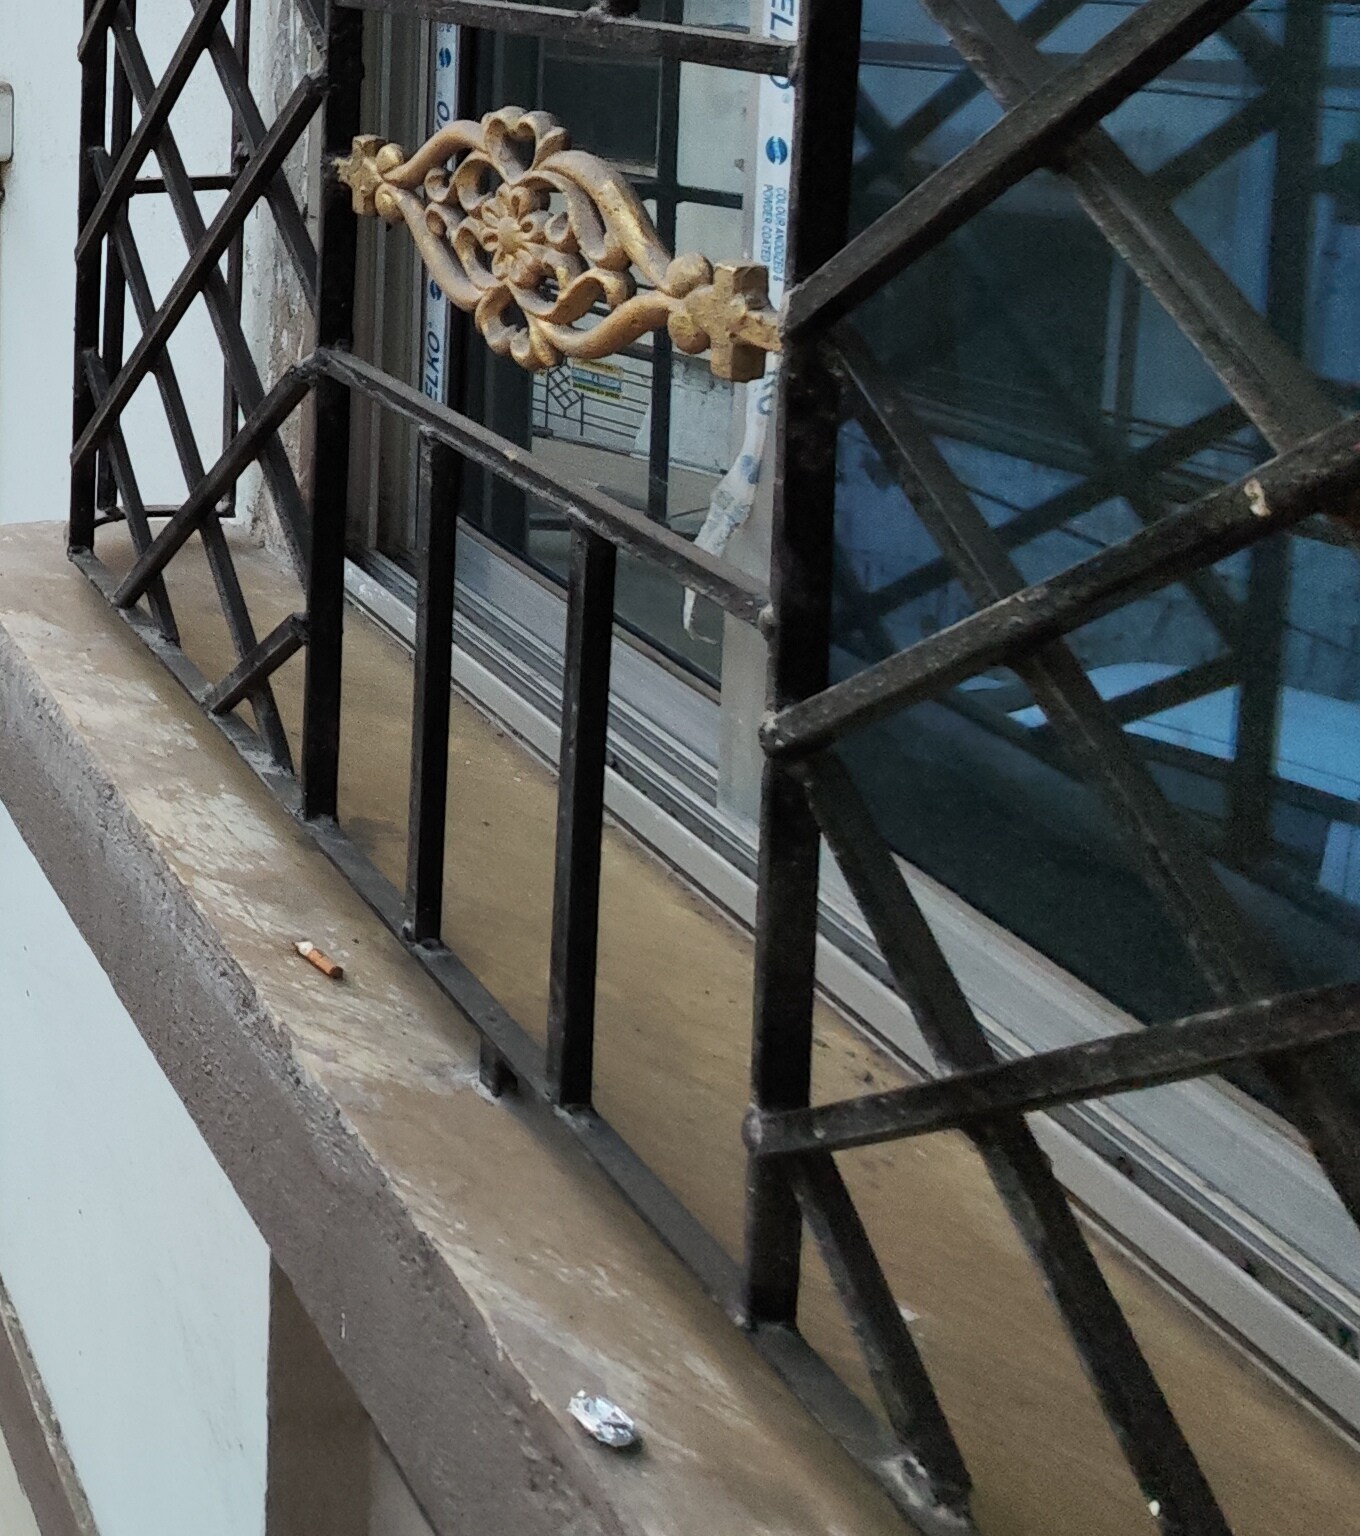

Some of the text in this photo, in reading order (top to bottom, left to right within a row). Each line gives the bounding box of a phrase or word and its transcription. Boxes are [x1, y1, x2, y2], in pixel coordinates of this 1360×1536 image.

[760, 184, 773, 262] POWDER COATED
[776, 187, 786, 227] COLOUR
